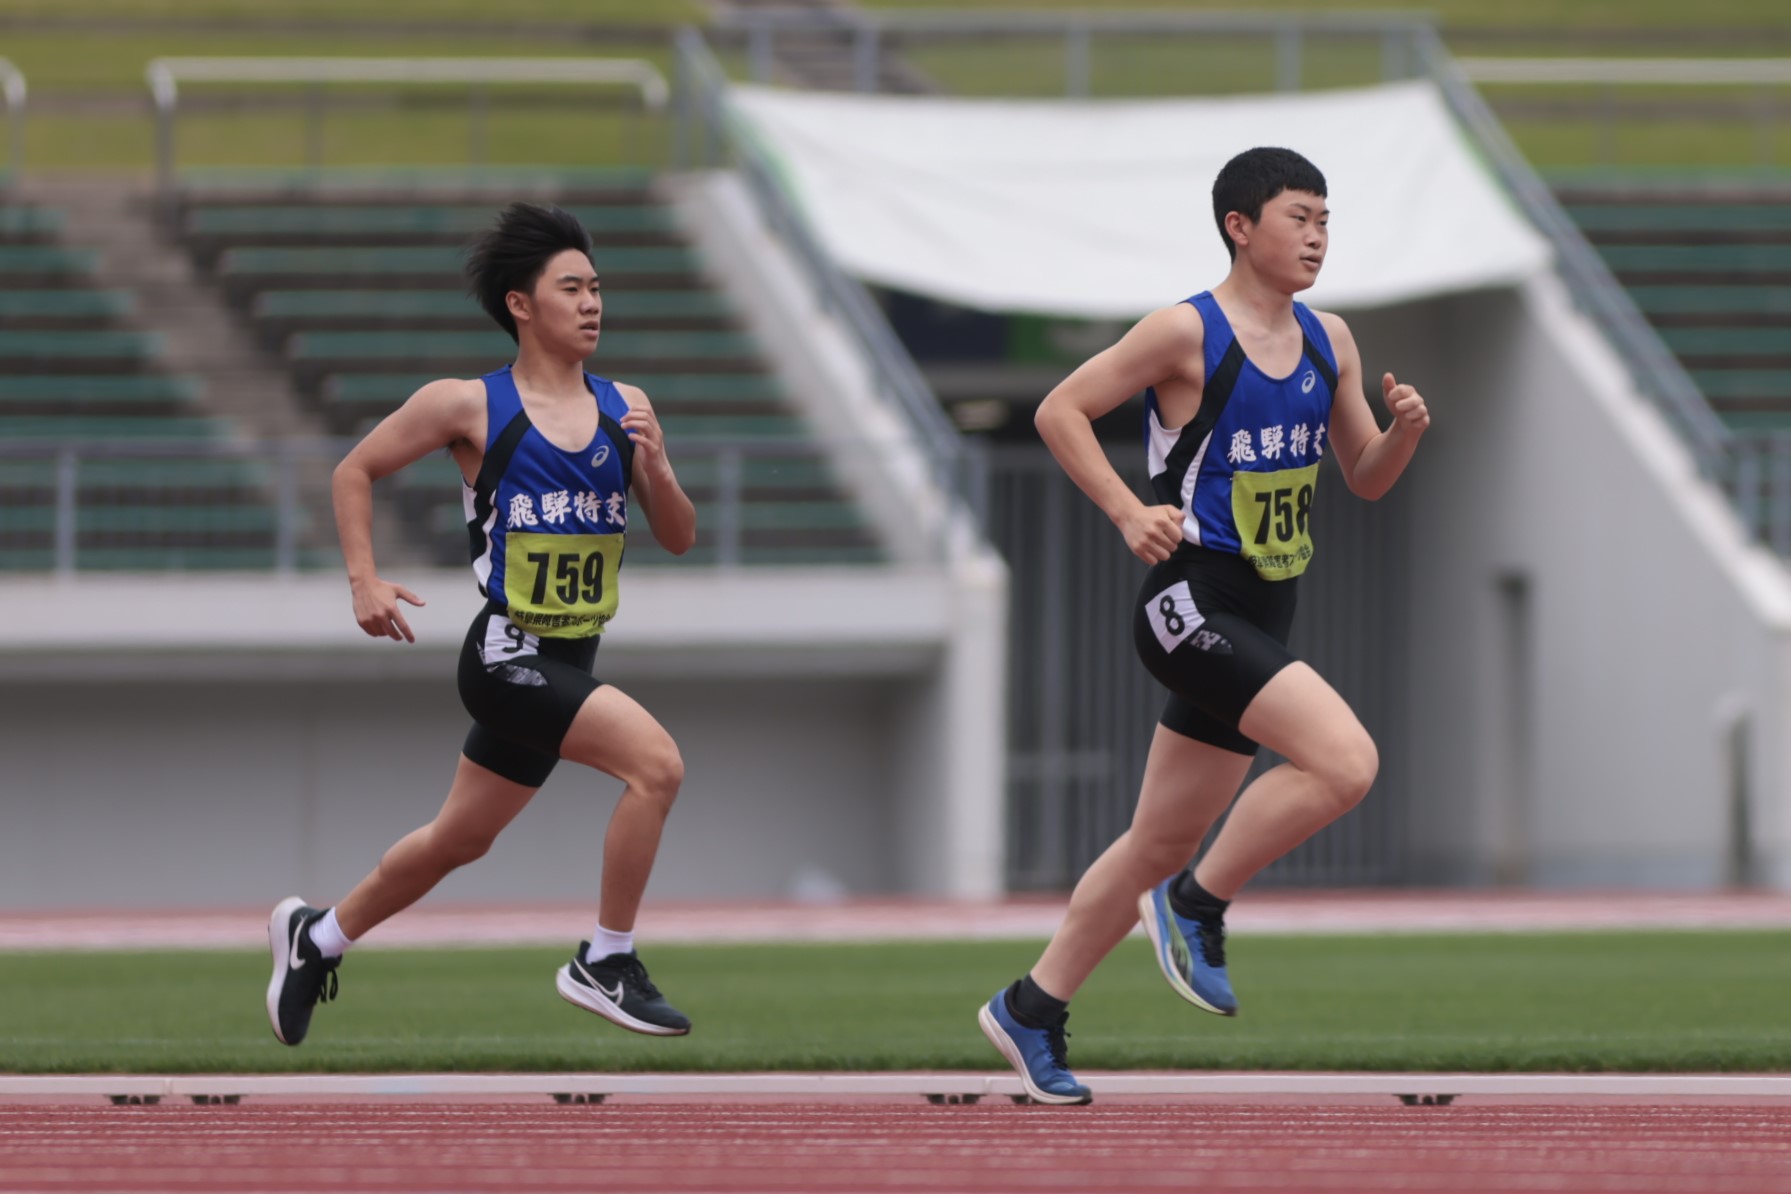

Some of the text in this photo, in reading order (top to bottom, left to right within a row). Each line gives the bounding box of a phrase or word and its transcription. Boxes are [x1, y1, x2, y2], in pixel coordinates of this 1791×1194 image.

[507, 489, 626, 529] 飛騨特支
[1254, 483, 1313, 545] 758
[528, 551, 604, 605] 759
[1159, 595, 1185, 636] 8
[502, 624, 525, 653] 9
